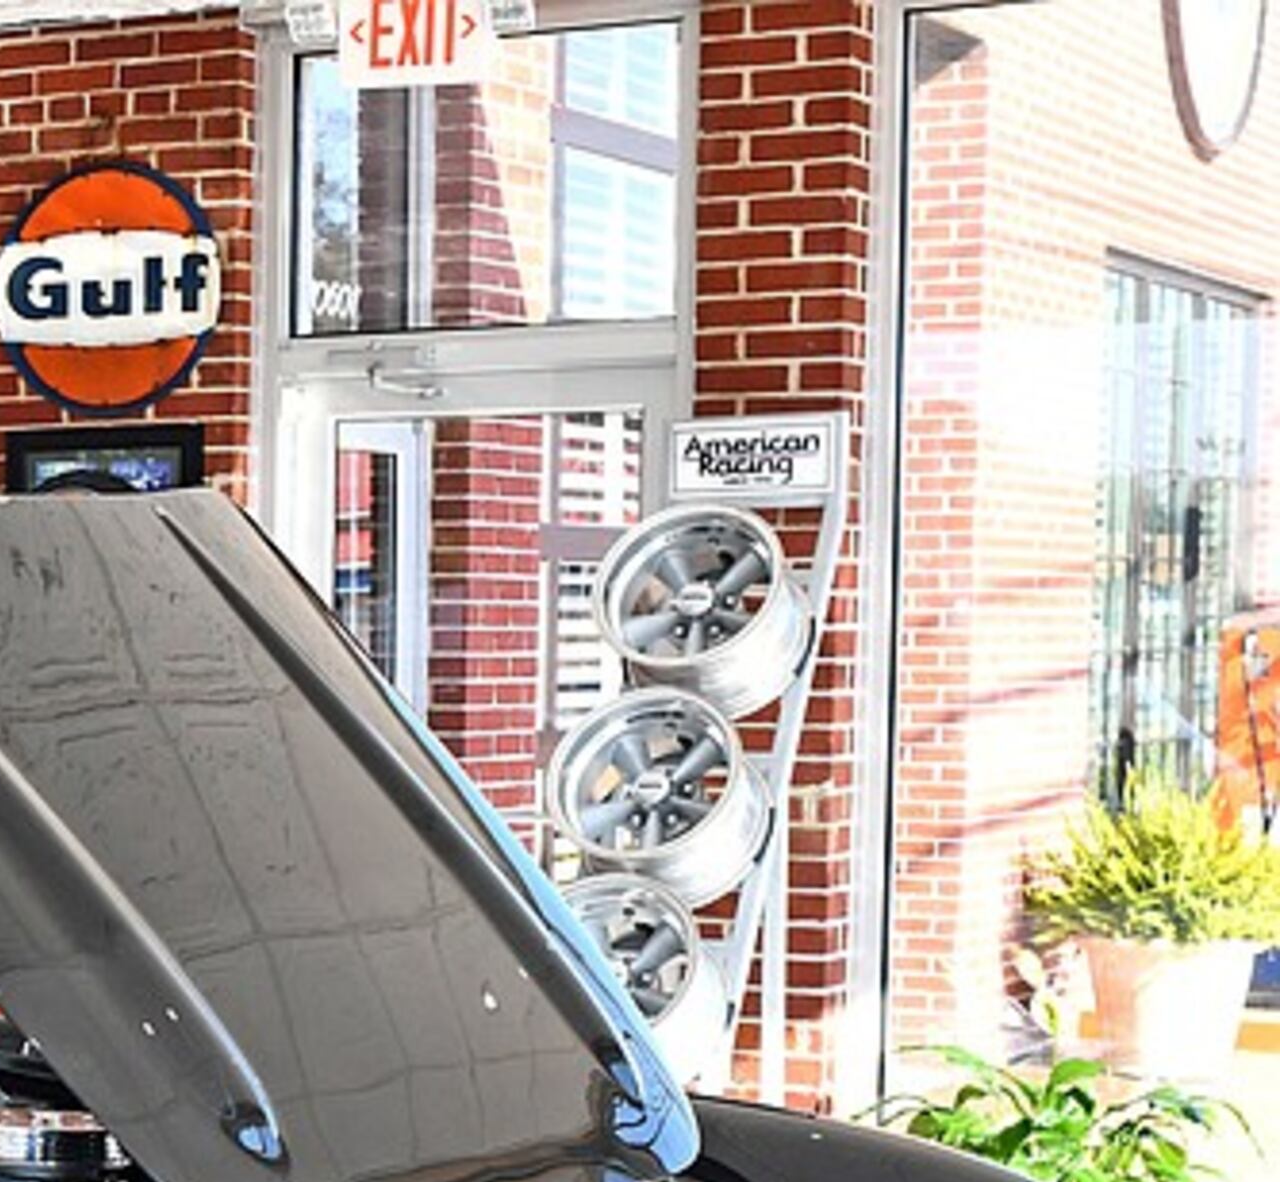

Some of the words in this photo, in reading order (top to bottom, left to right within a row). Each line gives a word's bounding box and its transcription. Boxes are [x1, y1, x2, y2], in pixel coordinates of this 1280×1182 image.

[368, 0, 458, 69] EXIT
[6, 253, 210, 320] Gulf
[683, 430, 821, 458] American
[698, 453, 795, 486] Racing
